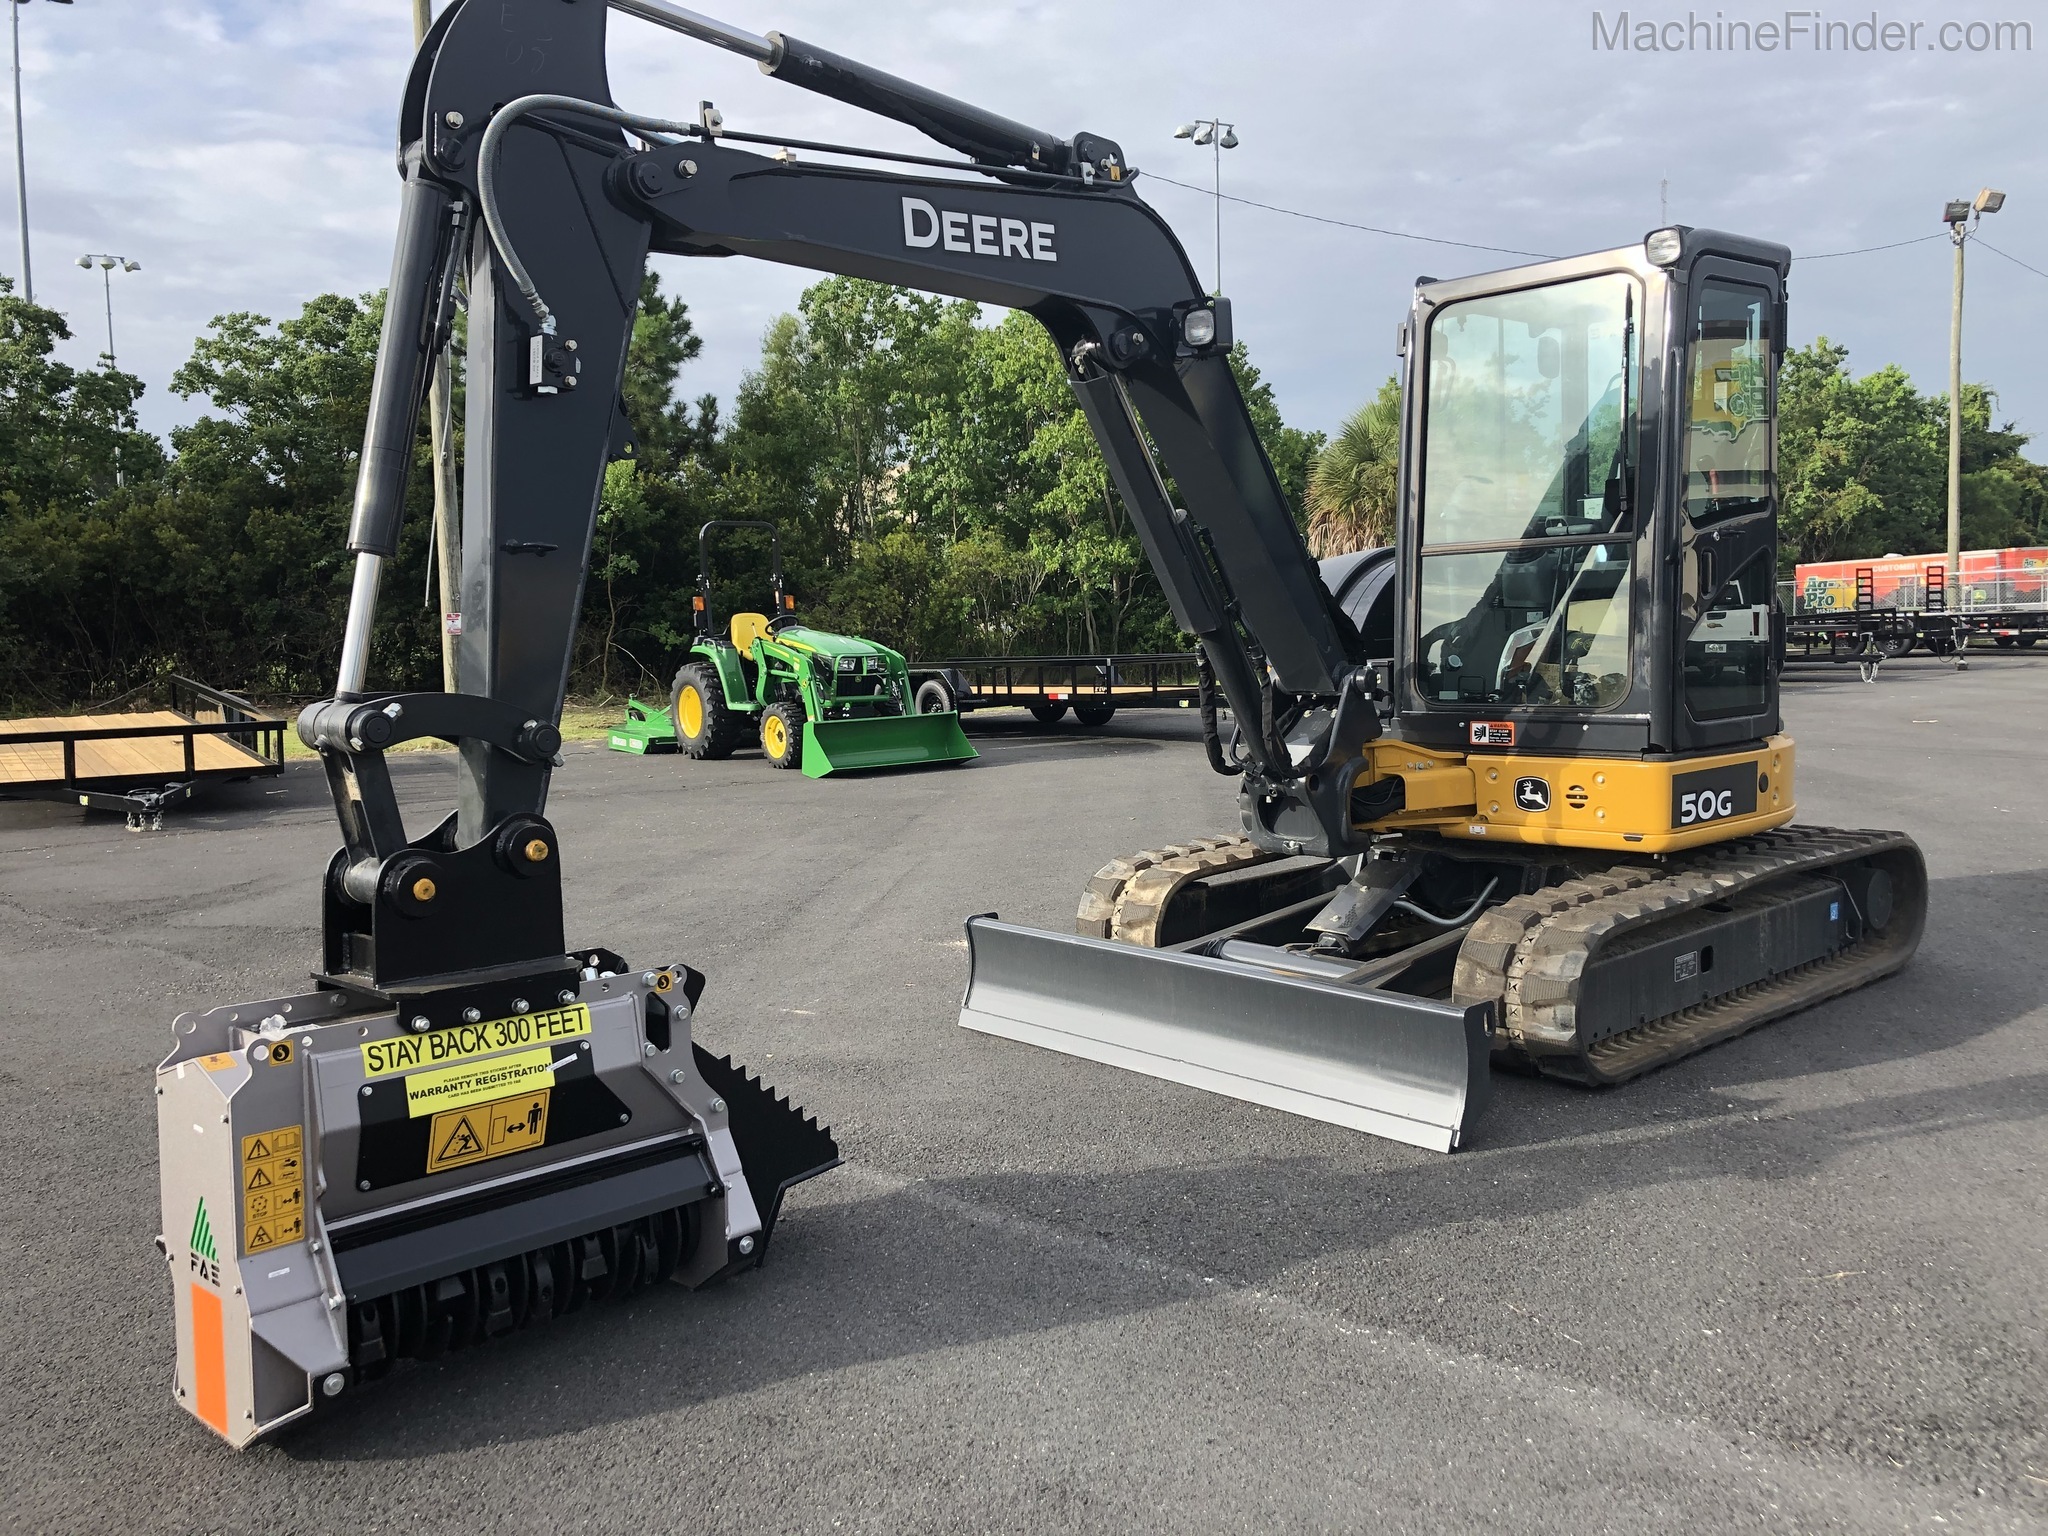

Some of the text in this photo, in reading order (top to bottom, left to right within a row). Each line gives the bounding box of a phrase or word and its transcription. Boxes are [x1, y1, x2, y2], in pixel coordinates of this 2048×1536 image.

[1804, 592, 1836, 608] Pro
[1680, 788, 1733, 824] 50G
[367, 1007, 585, 1072] STAY BACK 300 FEET
[461, 1072, 478, 1080] REMOVE
[409, 1079, 472, 1101] WARRANTY
[252, 1210, 268, 1219] STOP
[190, 1251, 221, 1287] FAE
